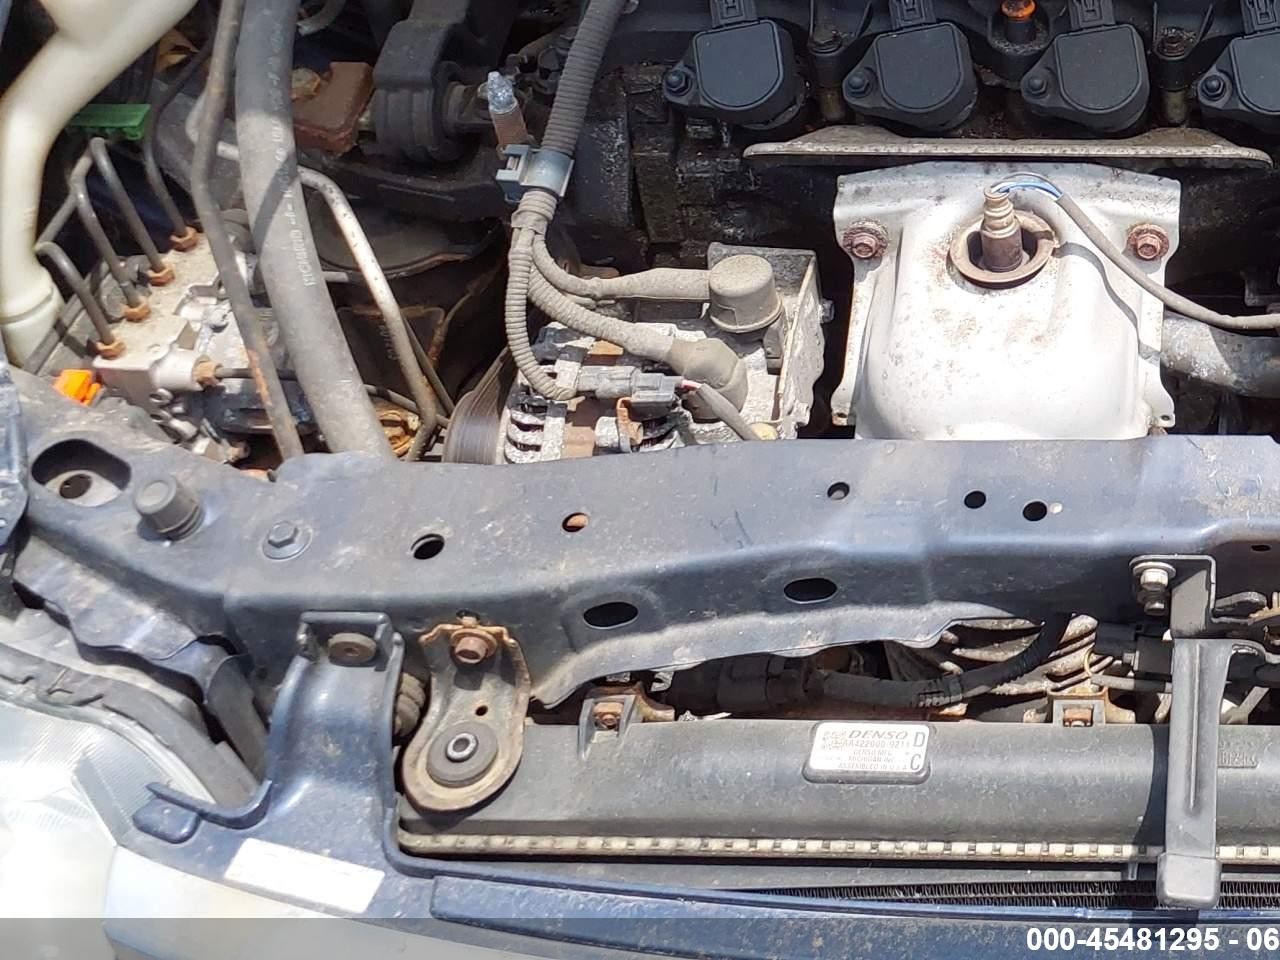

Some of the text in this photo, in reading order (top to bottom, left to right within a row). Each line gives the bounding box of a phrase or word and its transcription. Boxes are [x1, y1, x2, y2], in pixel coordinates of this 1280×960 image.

[848, 729, 909, 740] DENSO
[912, 731, 926, 748] D
[910, 753, 922, 771] C
